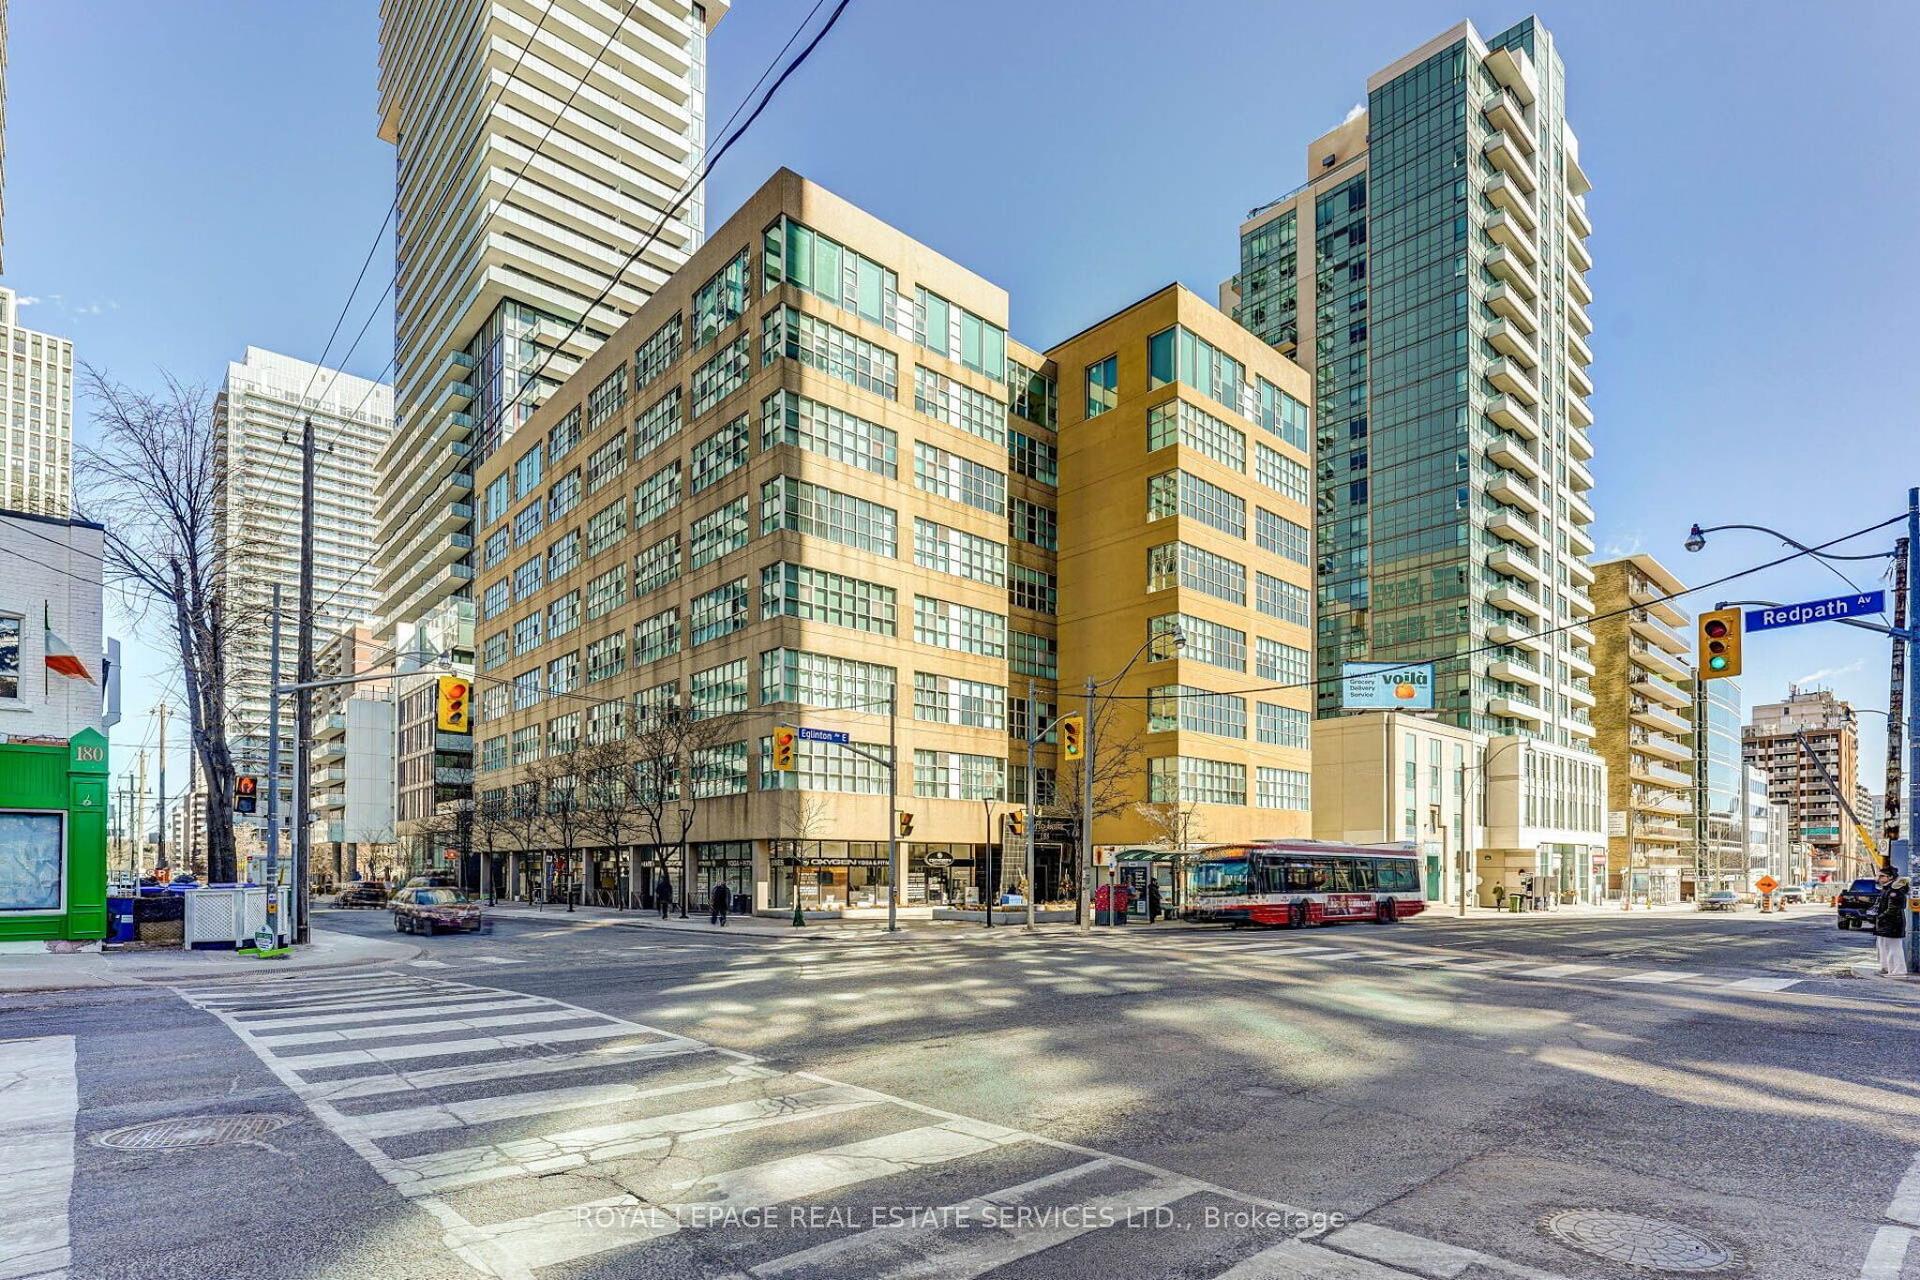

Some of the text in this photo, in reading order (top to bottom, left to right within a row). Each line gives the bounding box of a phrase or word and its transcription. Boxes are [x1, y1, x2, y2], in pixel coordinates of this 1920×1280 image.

[1763, 596, 1872, 625] Redpath Av
[1382, 672, 1428, 685] voilà
[801, 729, 832, 740] Eglinton
[841, 733, 848, 742] E
[76, 746, 104, 762] 180
[810, 858, 857, 866] OXYGEN
